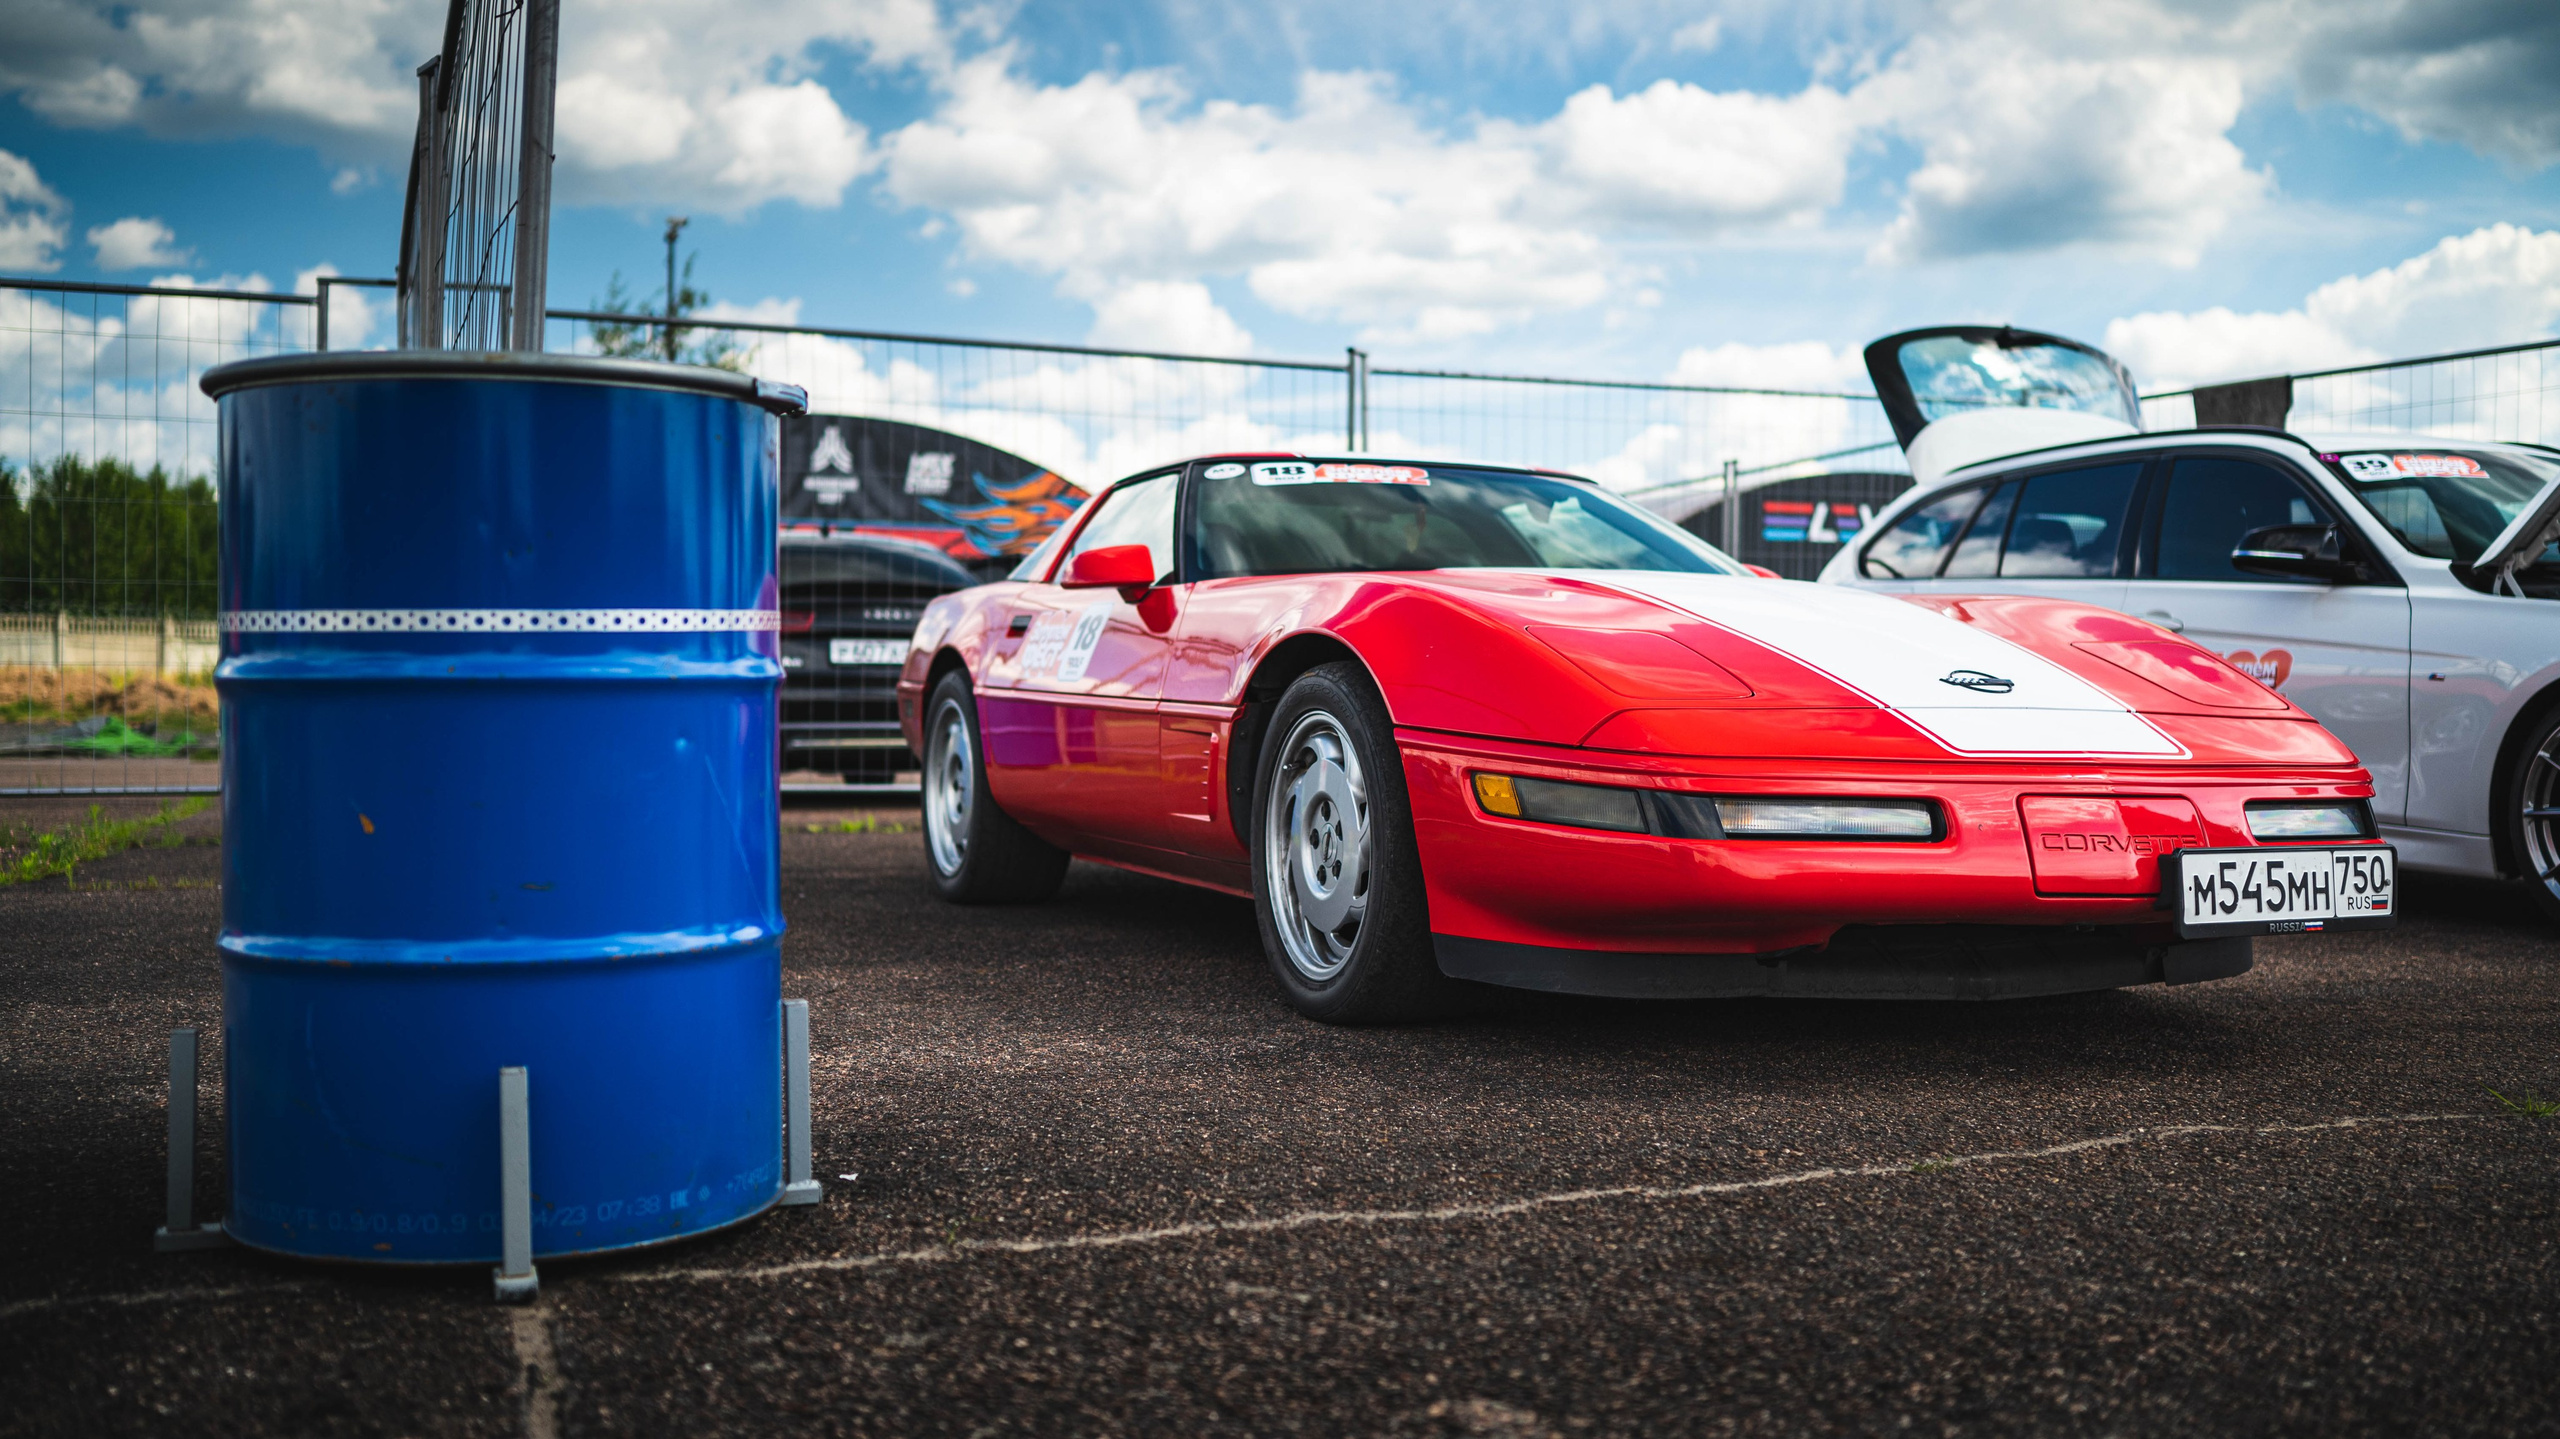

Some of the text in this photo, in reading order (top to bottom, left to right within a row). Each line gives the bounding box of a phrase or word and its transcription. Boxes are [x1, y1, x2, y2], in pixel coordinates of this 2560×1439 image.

[1260, 466, 1306, 476] 18
[1074, 614, 1103, 651] 18
[2040, 833, 2198, 856] CORVETTE
[2193, 855, 2386, 917] M545MH 750
[2347, 896, 2371, 911] RUS
[2269, 921, 2306, 934] RUSSIA
[597, 1194, 661, 1222] 07:38
